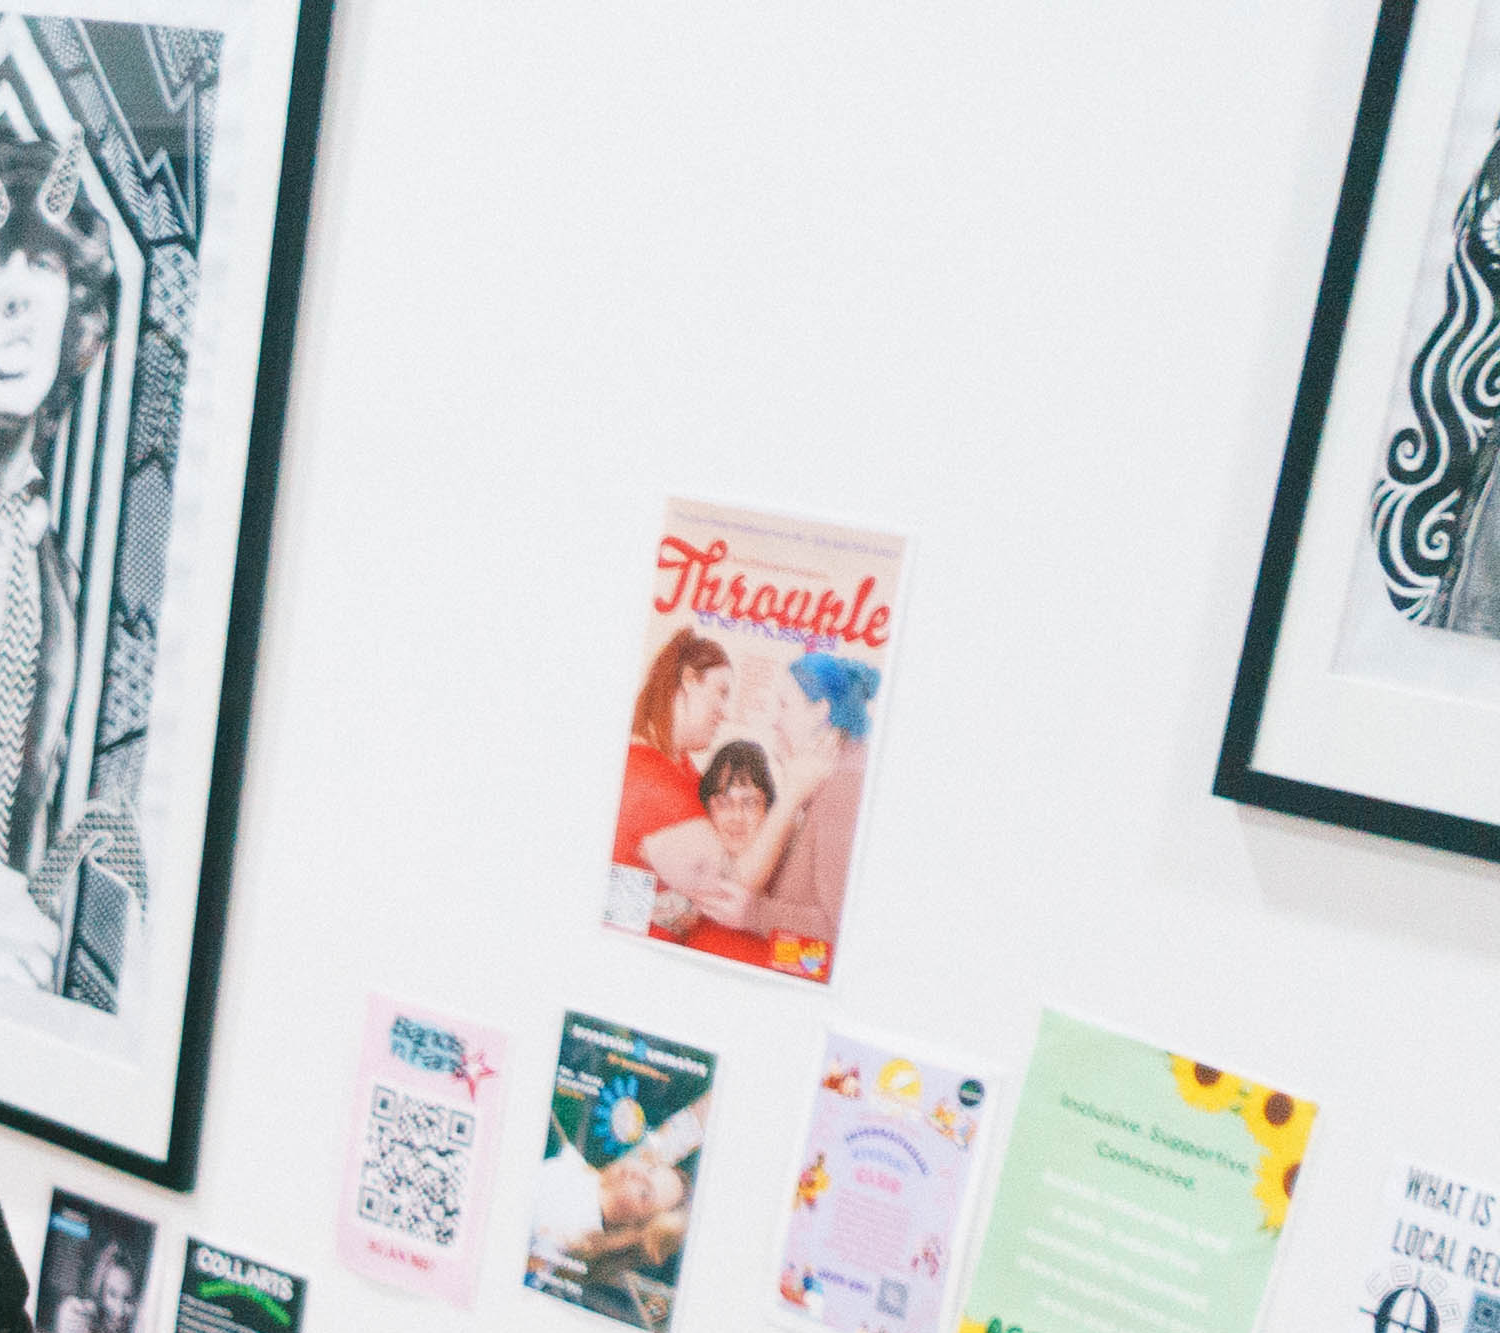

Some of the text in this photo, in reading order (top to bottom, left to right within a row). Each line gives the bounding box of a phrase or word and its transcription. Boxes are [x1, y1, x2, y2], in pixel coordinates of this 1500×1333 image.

[1405, 1165, 1496, 1228] WHAT IS
[1391, 1217, 1458, 1273] LOCAL
[196, 1246, 294, 1301] COLLARTS
